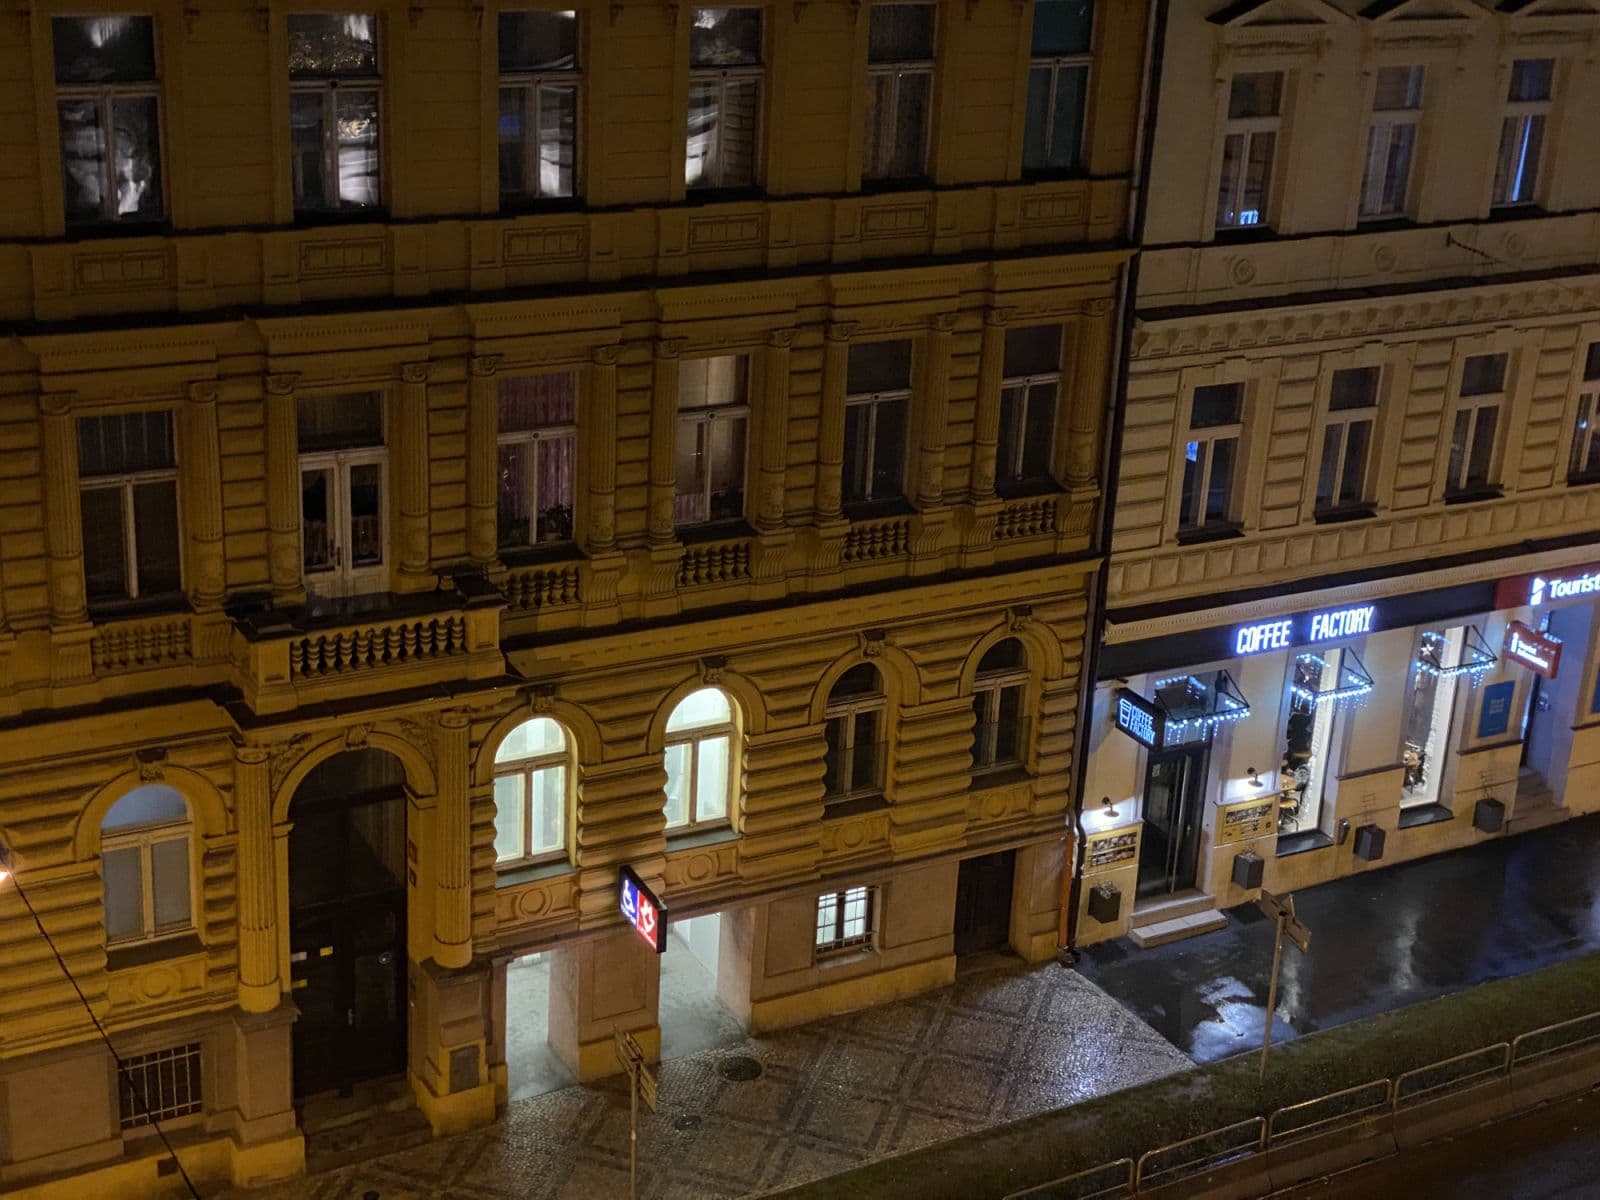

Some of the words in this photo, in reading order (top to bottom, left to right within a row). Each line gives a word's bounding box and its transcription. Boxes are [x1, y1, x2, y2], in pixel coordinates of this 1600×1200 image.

[1236, 619, 1293, 654] COFFEE
[1309, 606, 1375, 641] FACTORY
[1130, 717, 1156, 745] FACTORY
[1131, 705, 1154, 730] COFFEE
